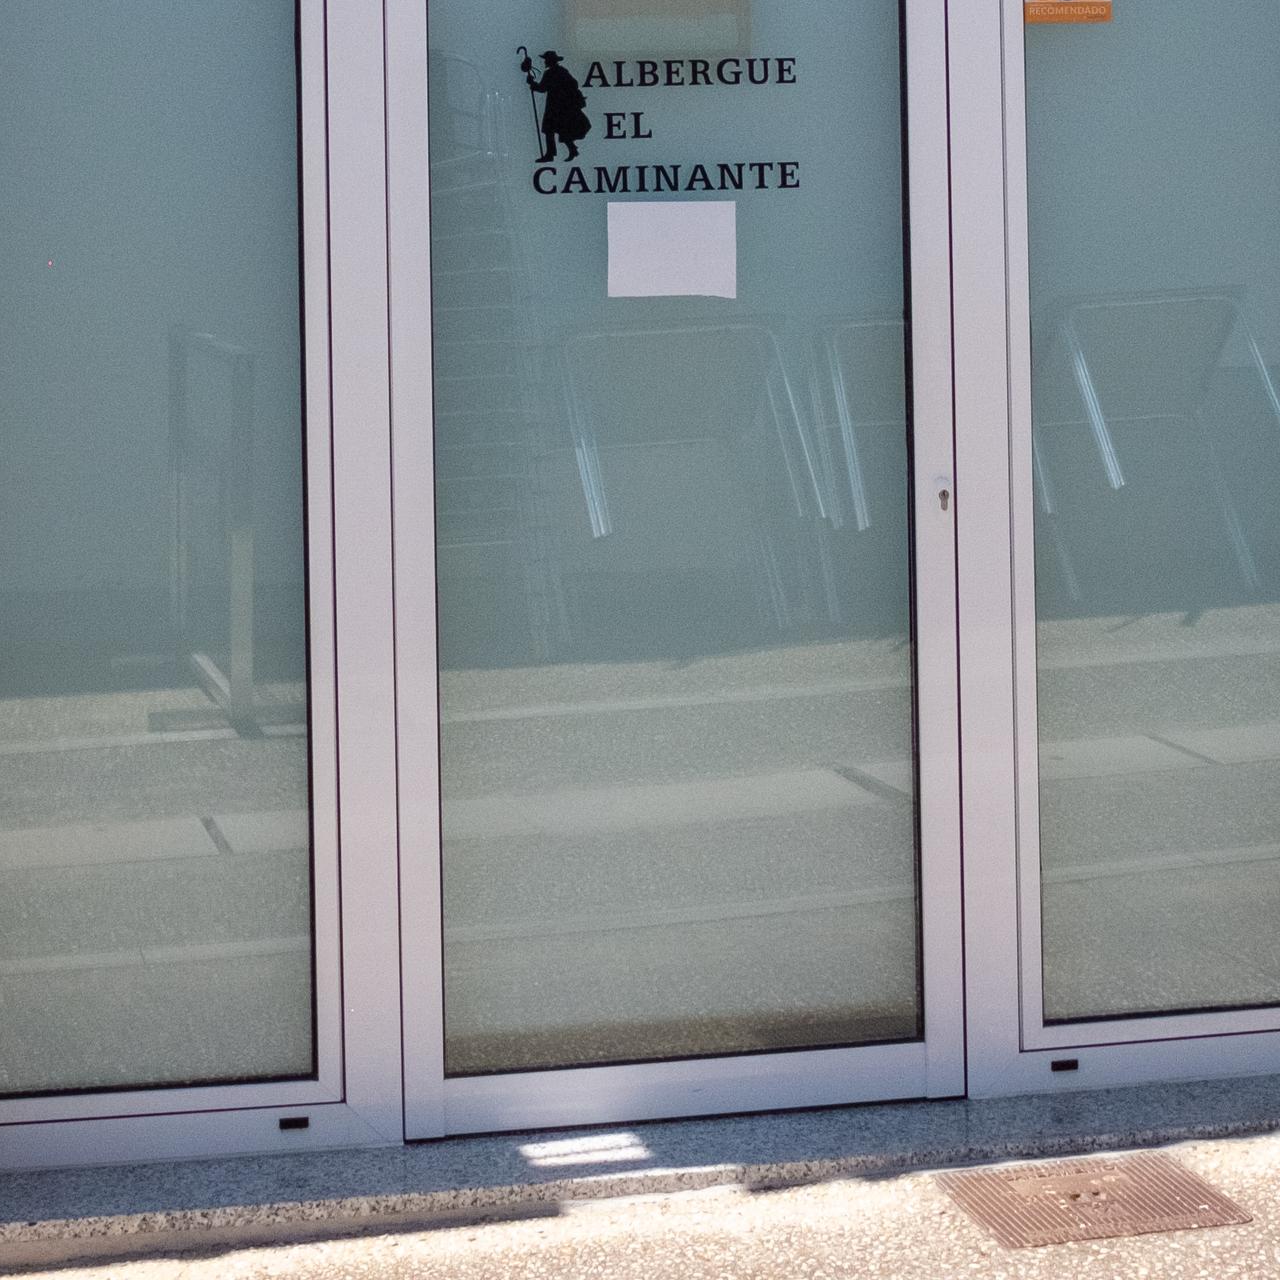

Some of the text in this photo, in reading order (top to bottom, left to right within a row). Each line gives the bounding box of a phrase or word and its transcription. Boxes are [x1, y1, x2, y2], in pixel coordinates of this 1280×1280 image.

[1029, 5, 1106, 16] RECOMENDADO
[582, 57, 797, 88] ALBERGUE
[603, 111, 653, 140] EL
[532, 161, 800, 195] CAMINANTE
